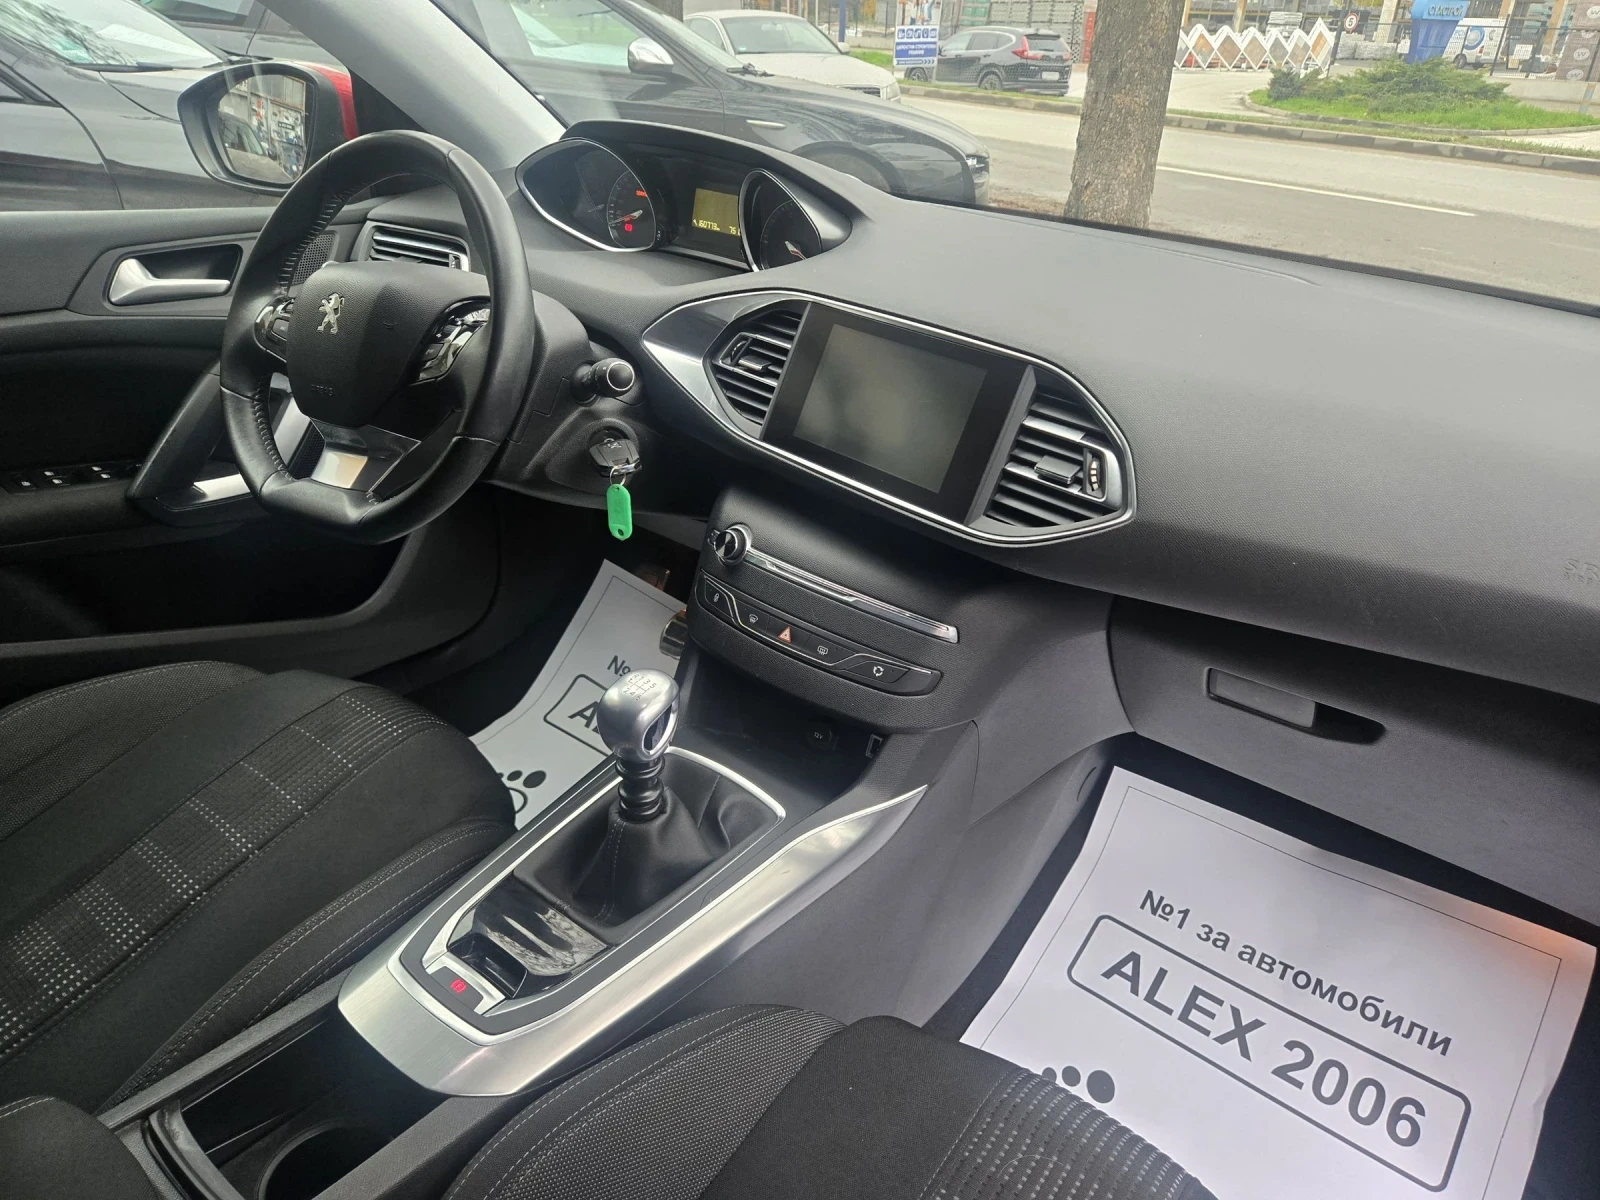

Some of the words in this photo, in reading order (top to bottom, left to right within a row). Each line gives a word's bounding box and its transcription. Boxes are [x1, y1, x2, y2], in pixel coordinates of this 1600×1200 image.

[1348, 17, 1354, 27] 5
[1100, 950, 1267, 1062] ALEX
[1270, 1039, 1428, 1149] 2006
[1139, 889, 1191, 930] №1
[1195, 923, 1231, 952] за
[1237, 942, 1454, 1057] автомобили
